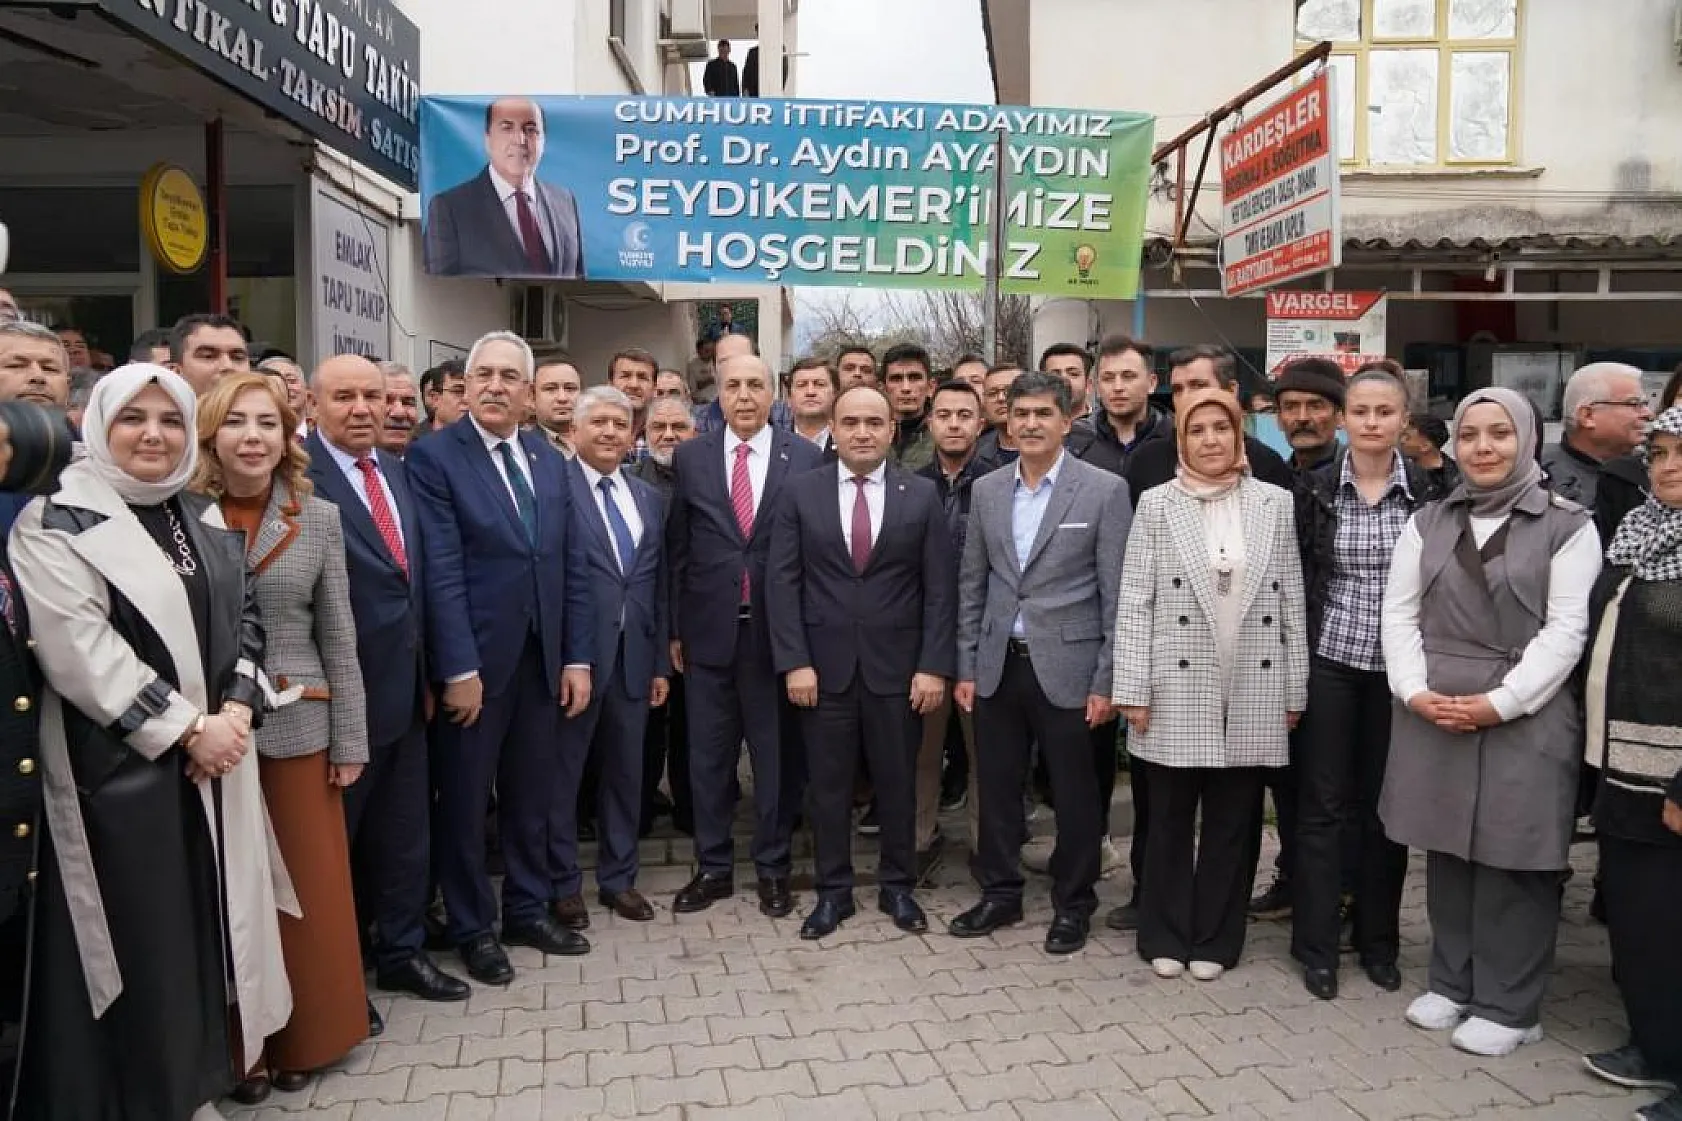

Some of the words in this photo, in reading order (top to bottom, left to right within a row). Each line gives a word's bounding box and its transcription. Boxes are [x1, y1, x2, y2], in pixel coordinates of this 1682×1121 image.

[296, 0, 356, 78] TAPU
[281, 57, 363, 141] TAKSİM
[614, 100, 773, 125] CUMHUR
[783, 102, 925, 131] İTTİFAKI
[934, 109, 1113, 138] ADAYIMIZ
[1223, 88, 1322, 171] KARDEŞLER
[614, 133, 709, 165] Prof.
[722, 135, 780, 166] Dr.
[790, 138, 909, 175] Aydın
[921, 141, 1110, 178] AYAYDIN
[335, 229, 372, 275] EMLAK
[677, 231, 1042, 280] HOŞGELDİNZ
[321, 274, 353, 315] TAPU
[354, 285, 385, 323] TAKİP
[1270, 293, 1360, 312] VARGEL
